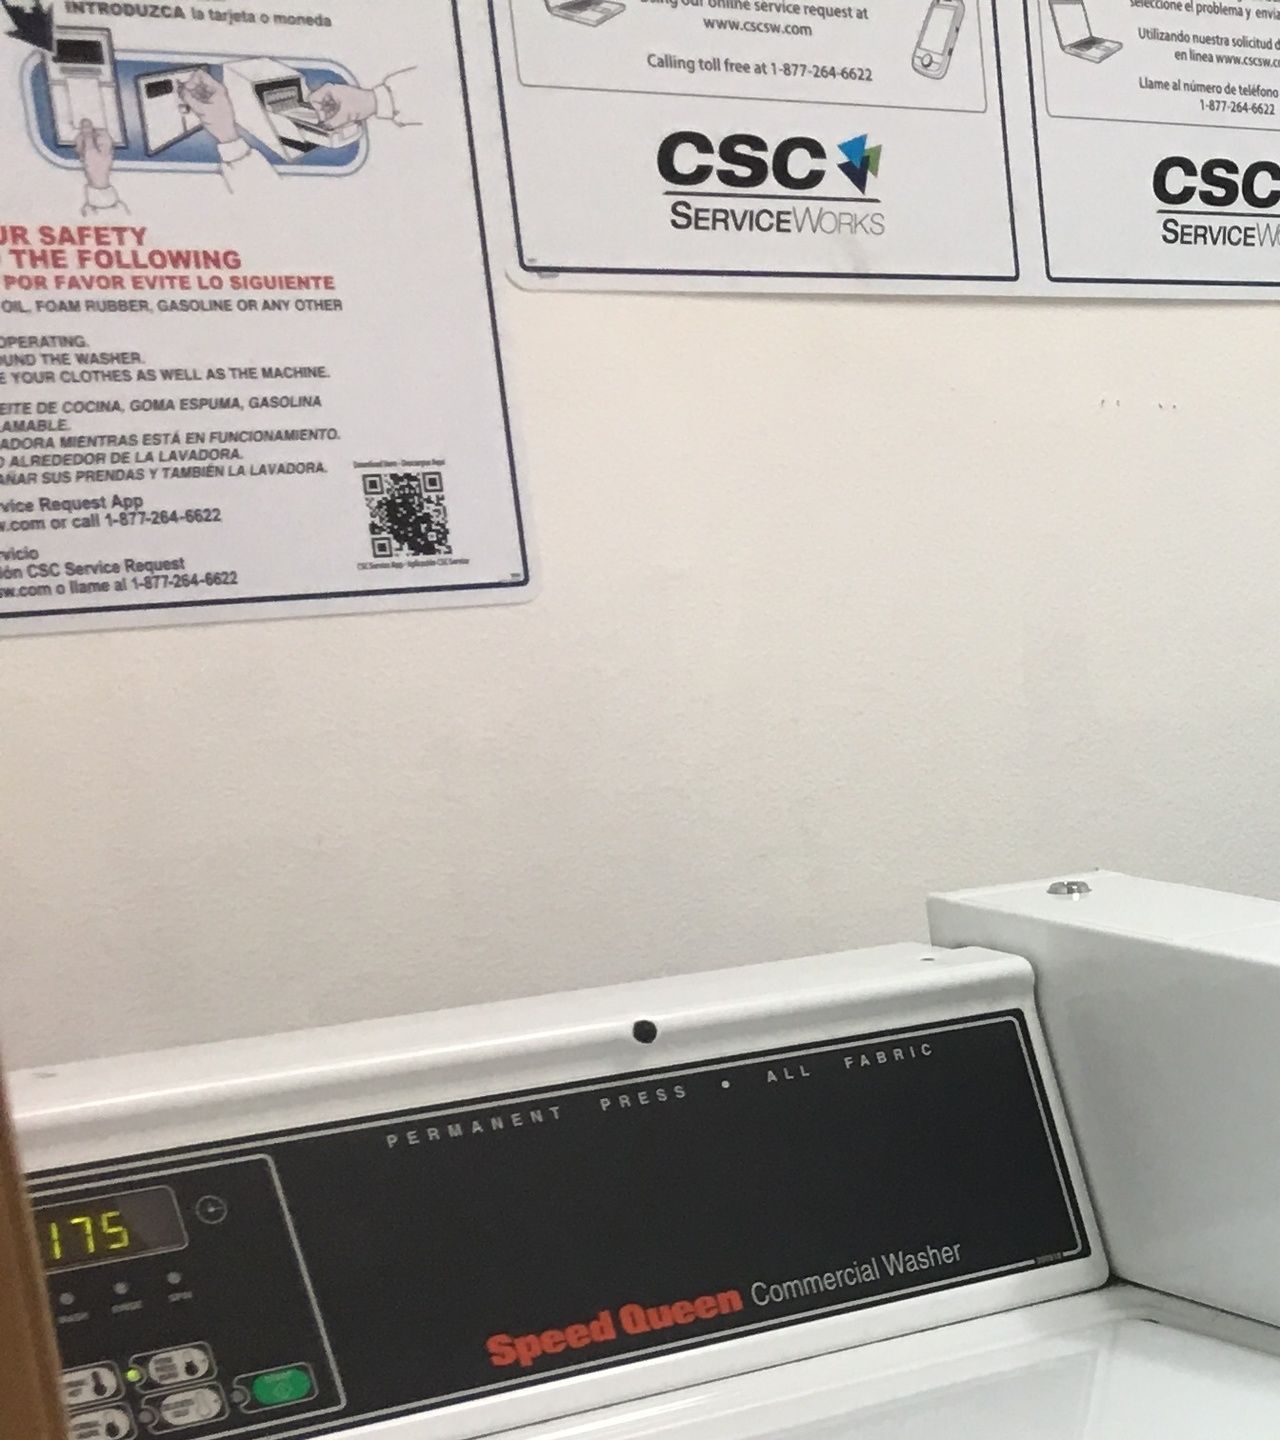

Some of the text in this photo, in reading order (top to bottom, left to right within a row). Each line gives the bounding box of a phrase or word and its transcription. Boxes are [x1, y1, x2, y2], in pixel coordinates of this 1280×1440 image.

[753, 0, 801, 14] service
[802, 4, 853, 19] request
[855, 7, 869, 20] at
[1184, 0, 1193, 12] el
[1195, 0, 1244, 16] problema
[1244, 7, 1251, 21] y
[702, 18, 812, 36] www.cscsw.com
[1137, 27, 1191, 43] Utilizando
[1191, 34, 1230, 46] nuestra
[1230, 35, 1273, 50] solicitud
[1173, 50, 1188, 61] en
[646, 53, 873, 81] Calling toll free at 1-877-264-6622
[1138, 76, 1170, 90] Llame
[1171, 78, 1181, 91] al
[1182, 80, 1222, 94] número
[1223, 81, 1237, 95] de
[1237, 83, 1279, 98] teléfono
[1199, 99, 1276, 116] 1-877-264-6622
[656, 131, 826, 190] CSC
[37, 225, 146, 246] SAFETY
[8, 249, 241, 269] THE FOLLOWING
[2, 274, 335, 290] POR FAVOR EVITE LO SIGUIENTE
[34, 299, 81, 312] FOAM
[83, 299, 153, 312] RUBBER,
[155, 298, 233, 312] GASOLINE
[235, 298, 258, 312] OR
[260, 298, 290, 311] ANY
[294, 298, 343, 311] OTHER
[38, 352, 71, 365] THE
[73, 352, 146, 365] WASHER.
[9, 366, 330, 384] YOUR CLOTHES AS WELL AS THE MACHINE.
[35, 400, 58, 415] DE
[61, 400, 125, 414] COCINA,
[128, 398, 175, 412] GOMA
[178, 397, 244, 410] ESPUMA,
[247, 395, 322, 408] GASOLINA
[58, 434, 139, 448] MIENTRAS
[141, 431, 181, 446] ESTÁ
[184, 431, 205, 444] EN
[208, 428, 340, 443] FUNCIONAMIENTO.
[7, 447, 243, 467] ALREDEDOR DE LA LAVADORA.
[40, 470, 72, 484] SUS
[74, 468, 145, 482] PRENDAS
[148, 467, 159, 479] Y
[161, 464, 225, 478] TAMBIÉN
[227, 464, 246, 477] LA
[249, 461, 327, 476] LAVADORA.
[37, 496, 107, 513] Request
[110, 494, 144, 512] App
[49, 517, 67, 530] or
[70, 512, 100, 528] call
[103, 507, 222, 526] 1-877-264-6622
[25, 562, 61, 578] CSC
[63, 560, 121, 576] Service
[123, 557, 185, 574] Request
[54, 583, 66, 595] o
[68, 579, 110, 594] llame
[113, 577, 128, 592] al
[130, 571, 238, 589] 1-877-264-6622
[386, 1043, 932, 1149] PERMANENT PRESS ALL FABRIC
[50, 1210, 129, 1260] 175
[485, 1243, 961, 1367] Speed Queen Commercial Washer
